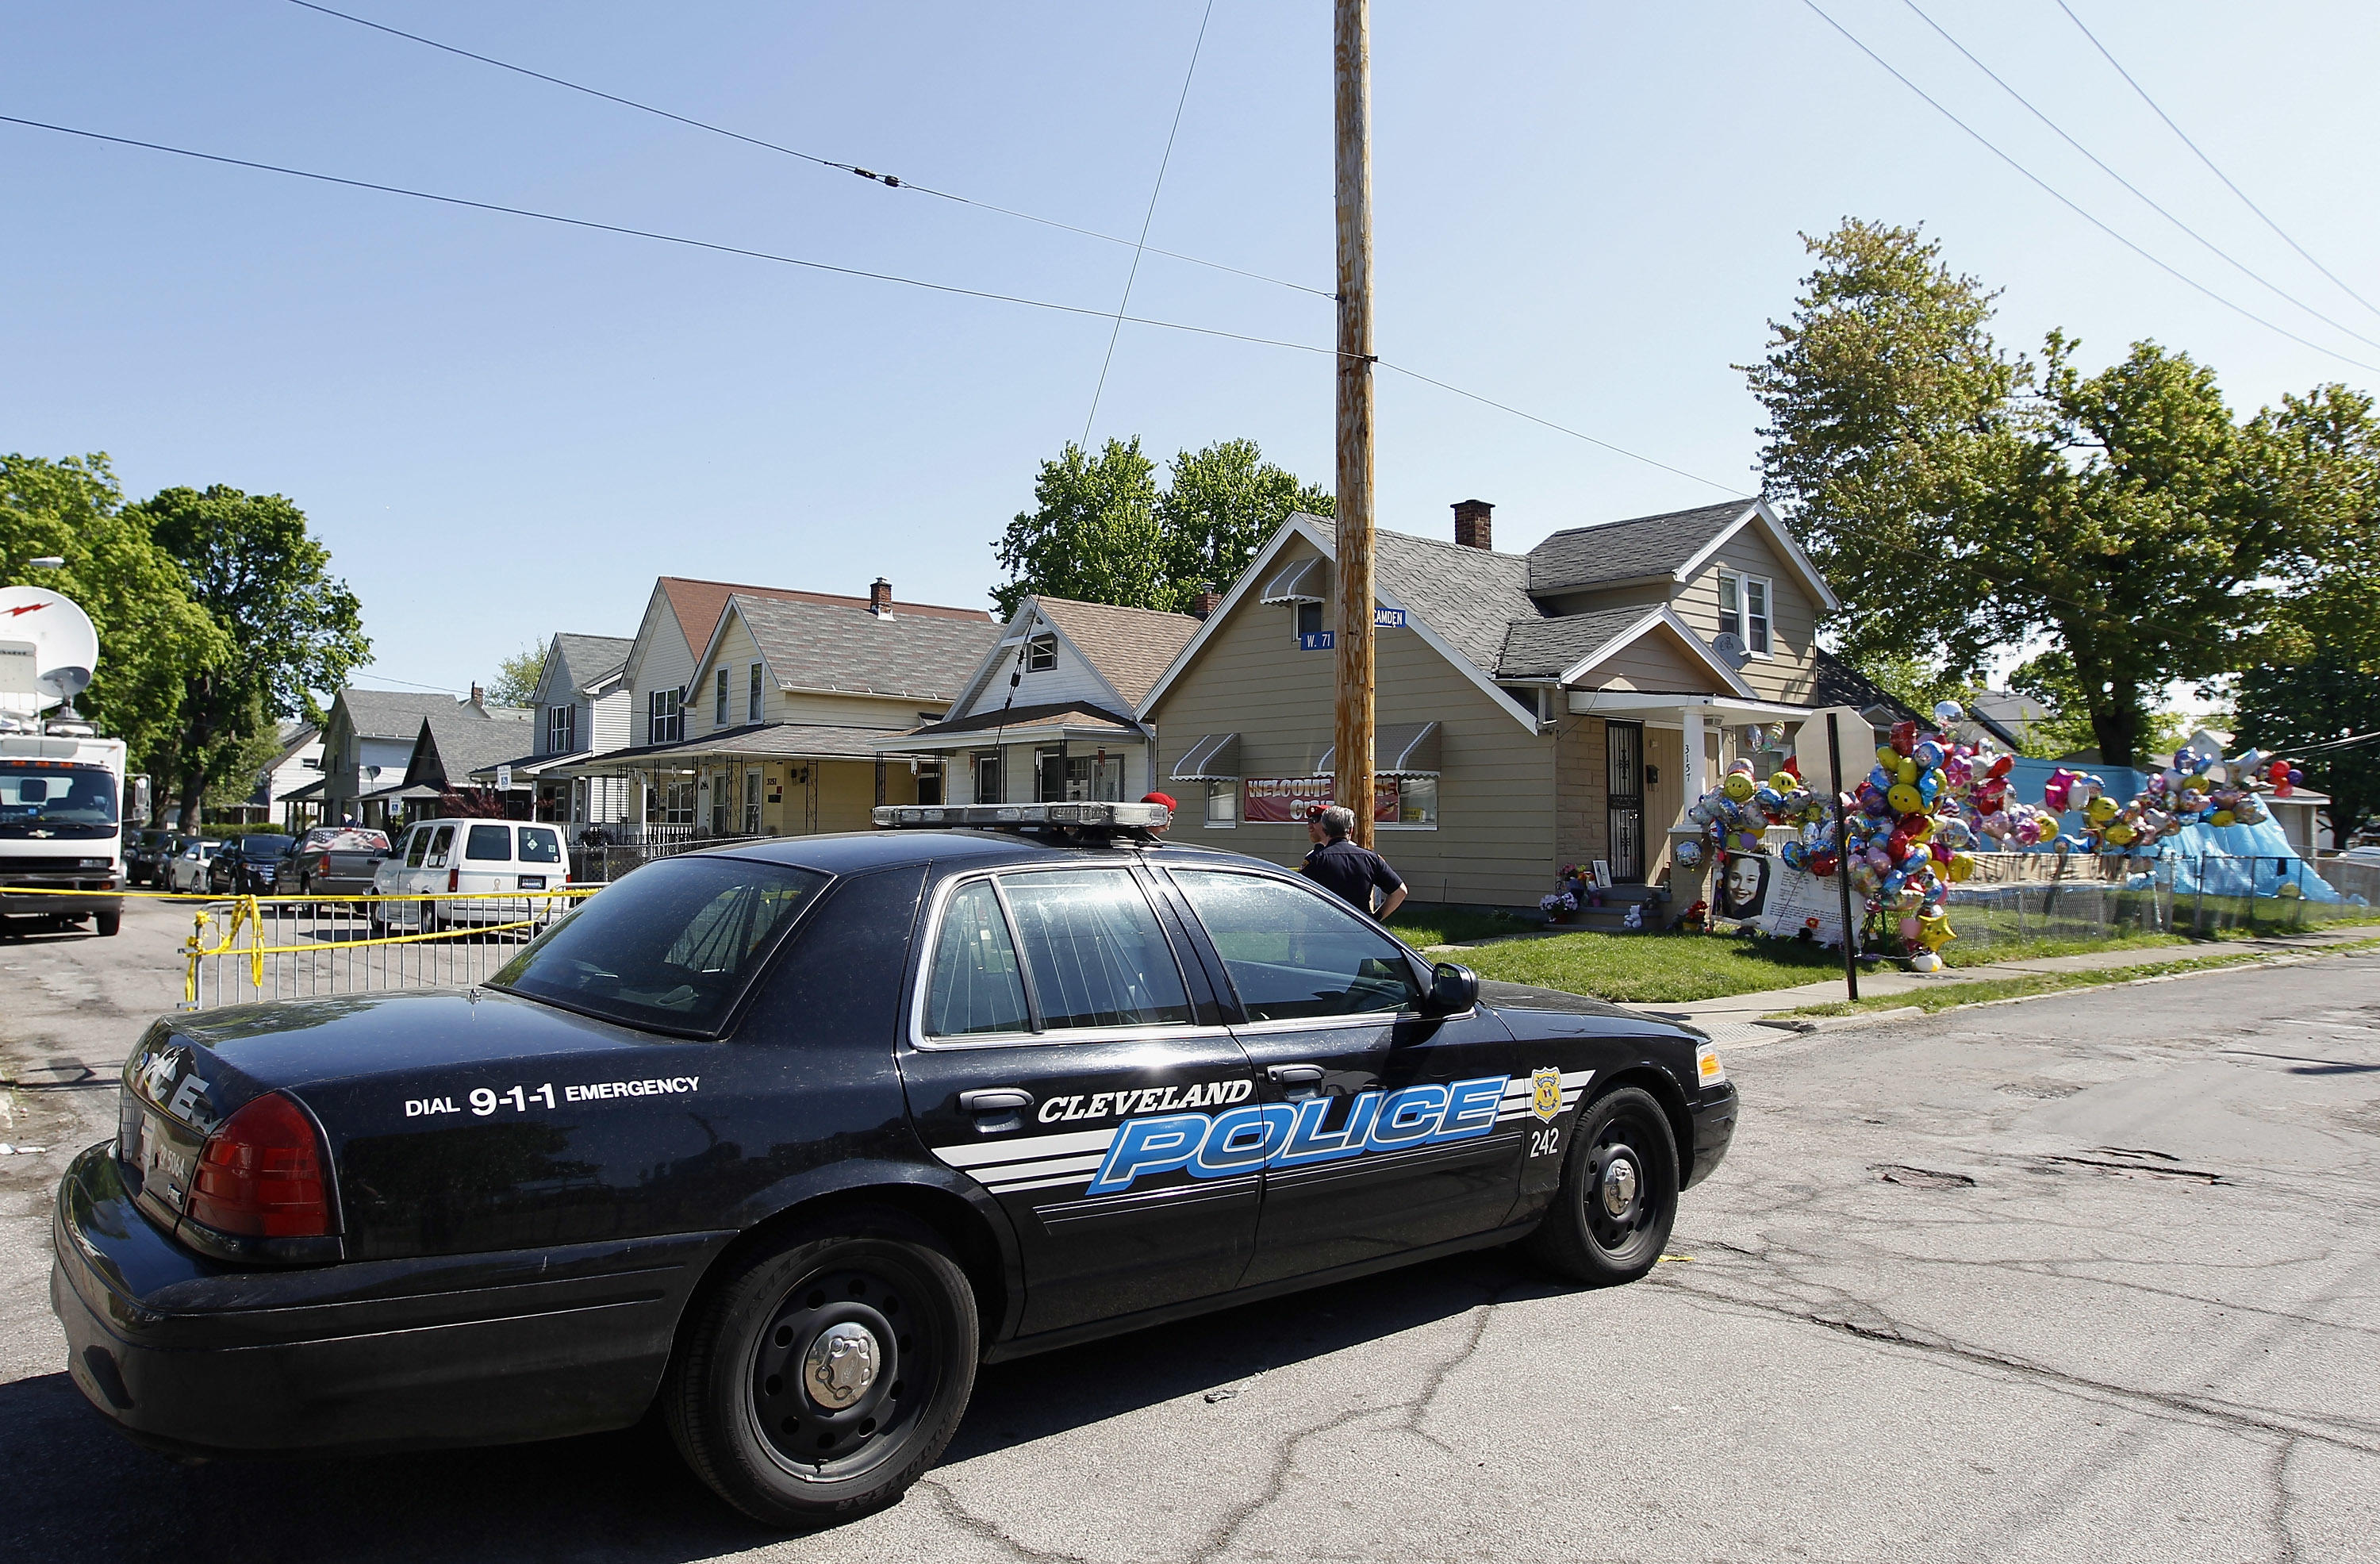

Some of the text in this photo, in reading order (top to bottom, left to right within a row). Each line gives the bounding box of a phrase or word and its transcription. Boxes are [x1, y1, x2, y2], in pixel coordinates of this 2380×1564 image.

[1307, 633, 1331, 648] W. 71
[1248, 778, 1332, 798] WELCOME
[405, 1076, 701, 1117] DIAL 9-1-1 EMERGENCY
[1038, 1078, 1253, 1124] CLEVELAND
[1086, 1074, 1511, 1196] POLICE
[1530, 1128, 1558, 1159] 242
[167, 1150, 185, 1181] 5064
